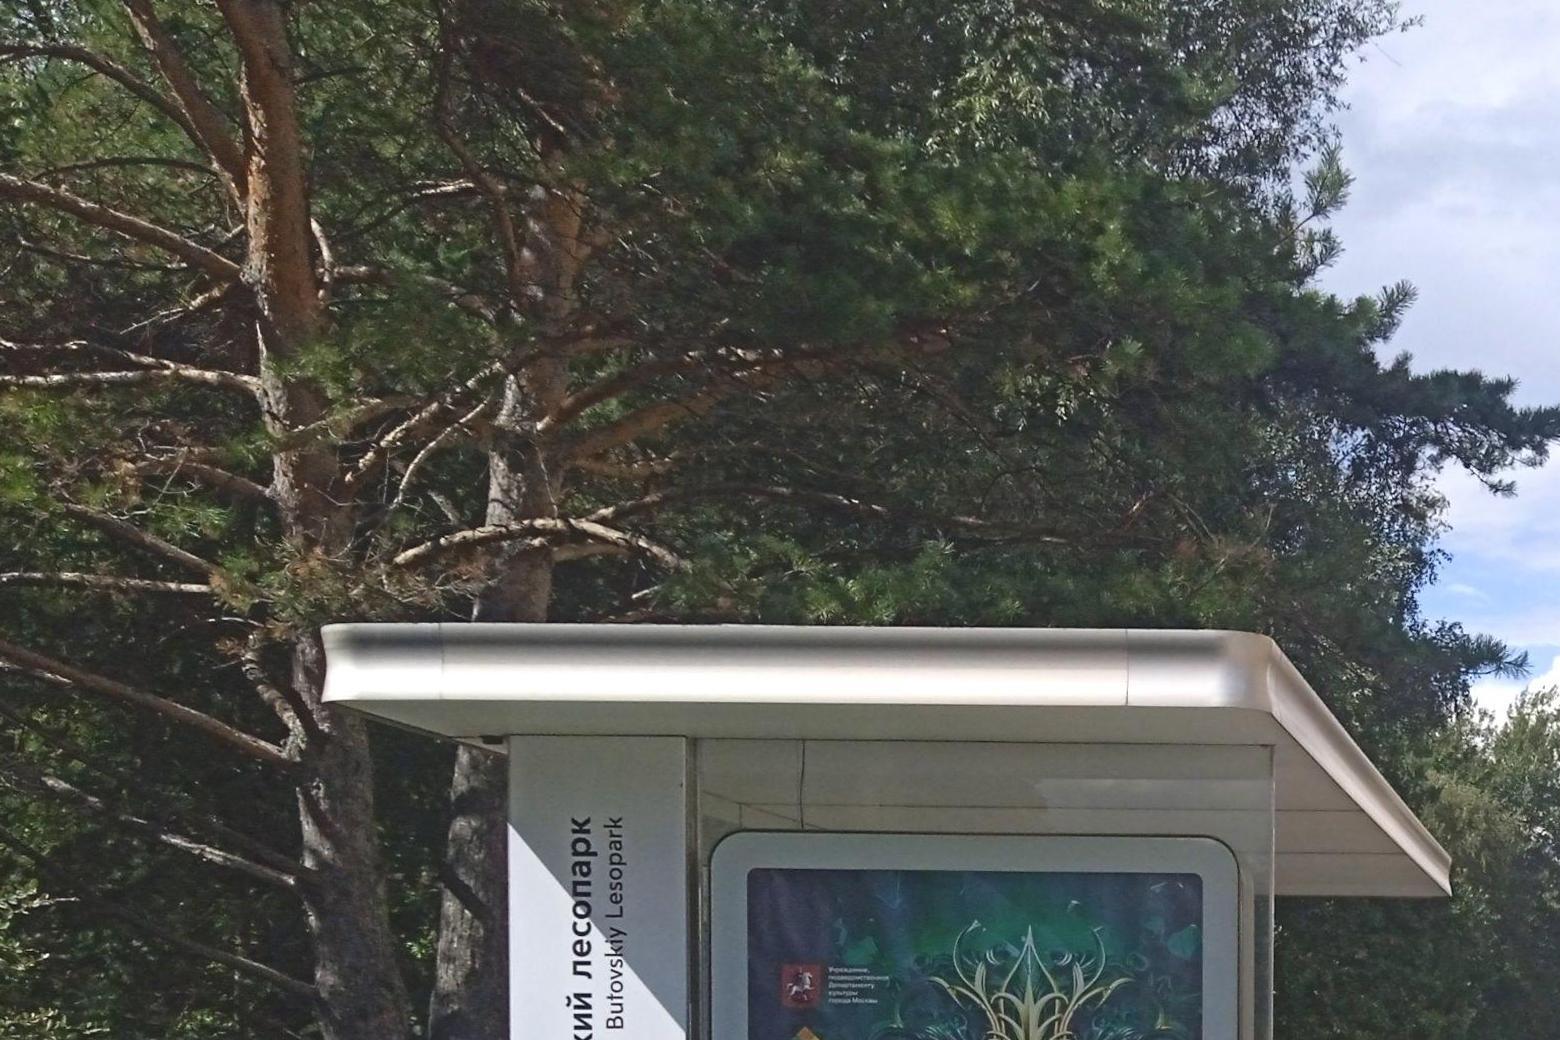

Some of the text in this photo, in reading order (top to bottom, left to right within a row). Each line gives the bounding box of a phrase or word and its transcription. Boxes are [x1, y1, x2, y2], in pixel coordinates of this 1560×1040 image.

[570, 816, 598, 980] лесопарк
[604, 816, 628, 1030] Butovskiy Lesopark
